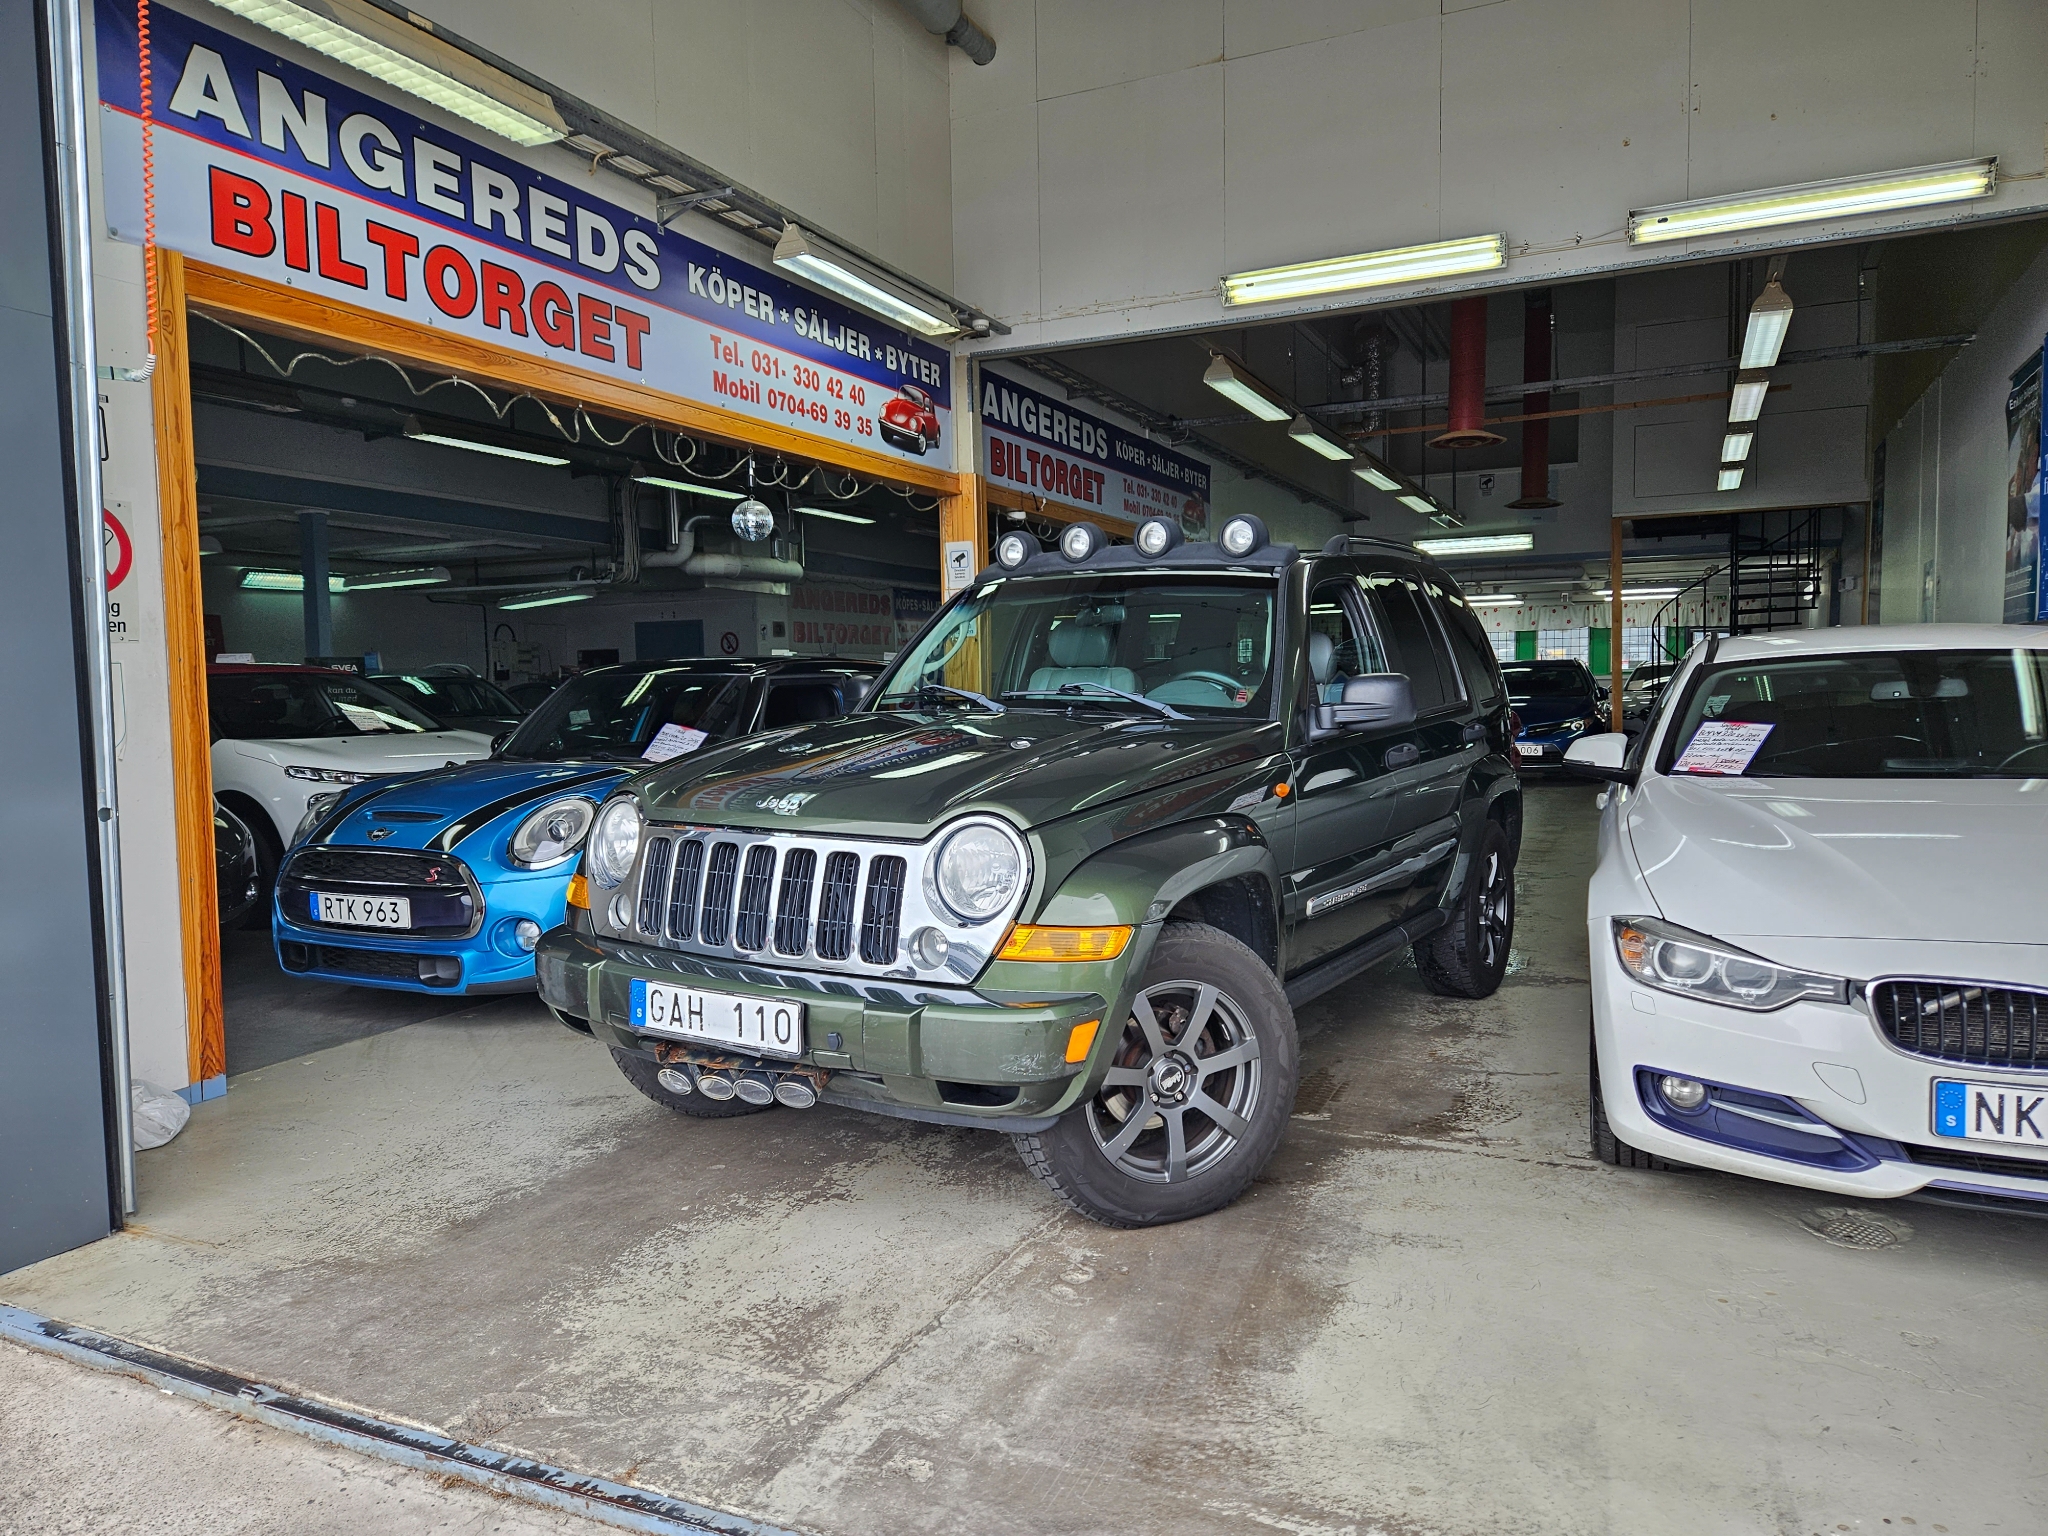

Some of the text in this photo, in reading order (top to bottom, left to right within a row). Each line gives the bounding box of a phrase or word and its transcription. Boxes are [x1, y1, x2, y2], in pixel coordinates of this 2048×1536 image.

[168, 43, 662, 291] ANGEREDS
[208, 164, 651, 371] BILTORGET
[687, 262, 941, 388] KÖPER SÄLJER BYTER
[710, 334, 866, 407] Tel. 031- 330 42 40
[712, 370, 873, 437] Mobil 0704-69 39 35
[982, 381, 1108, 460] ANGEREDS
[990, 436, 1105, 505] BILTORGET
[1115, 440, 1208, 490] KÖPER SÄLJER BYTER
[1123, 478, 1135, 495] Tel.
[1151, 488, 1162, 503] 330
[1123, 498, 1141, 515] Mobil
[792, 587, 891, 616] ANGEREDS
[793, 621, 892, 645] BILTORGET
[327, 686, 343, 694] kan
[1520, 746, 1539, 755] 006
[756, 795, 801, 812] Jeep
[324, 897, 357, 921] RTK
[363, 900, 400, 923] 963
[636, 989, 791, 1045] S GAH 110
[1945, 1091, 2045, 1139] S NK
